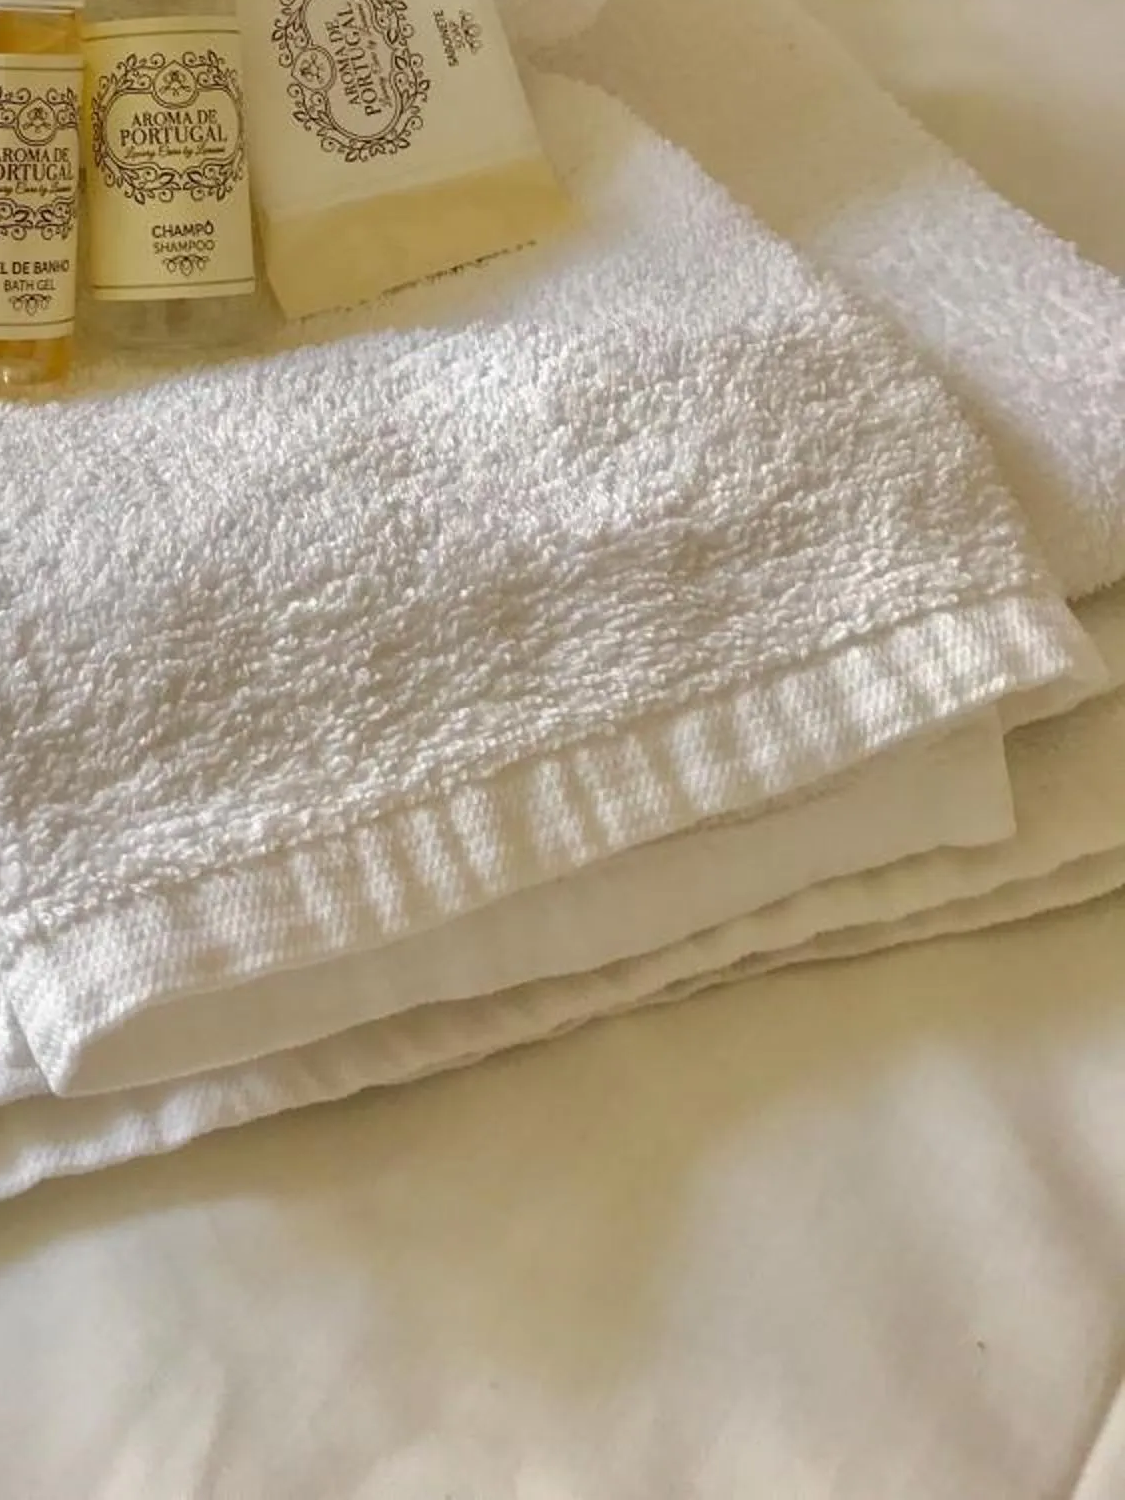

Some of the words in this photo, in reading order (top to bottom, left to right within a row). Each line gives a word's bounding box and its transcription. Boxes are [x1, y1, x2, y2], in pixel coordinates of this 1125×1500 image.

[325, 18, 344, 44] DE
[433, 8, 459, 68] SABONETE
[337, 1, 382, 117] PORTUGAL
[335, 47, 361, 106] AROMA
[131, 111, 193, 127] AROMA
[197, 108, 218, 125] DE
[119, 124, 227, 147] PORTUGAL
[53, 147, 70, 162] DE
[153, 239, 216, 254] SHAMPOO
[11, 261, 30, 275] DE
[33, 258, 71, 274] BANHO
[4, 279, 34, 292] BATH
[37, 278, 56, 292] GEL
